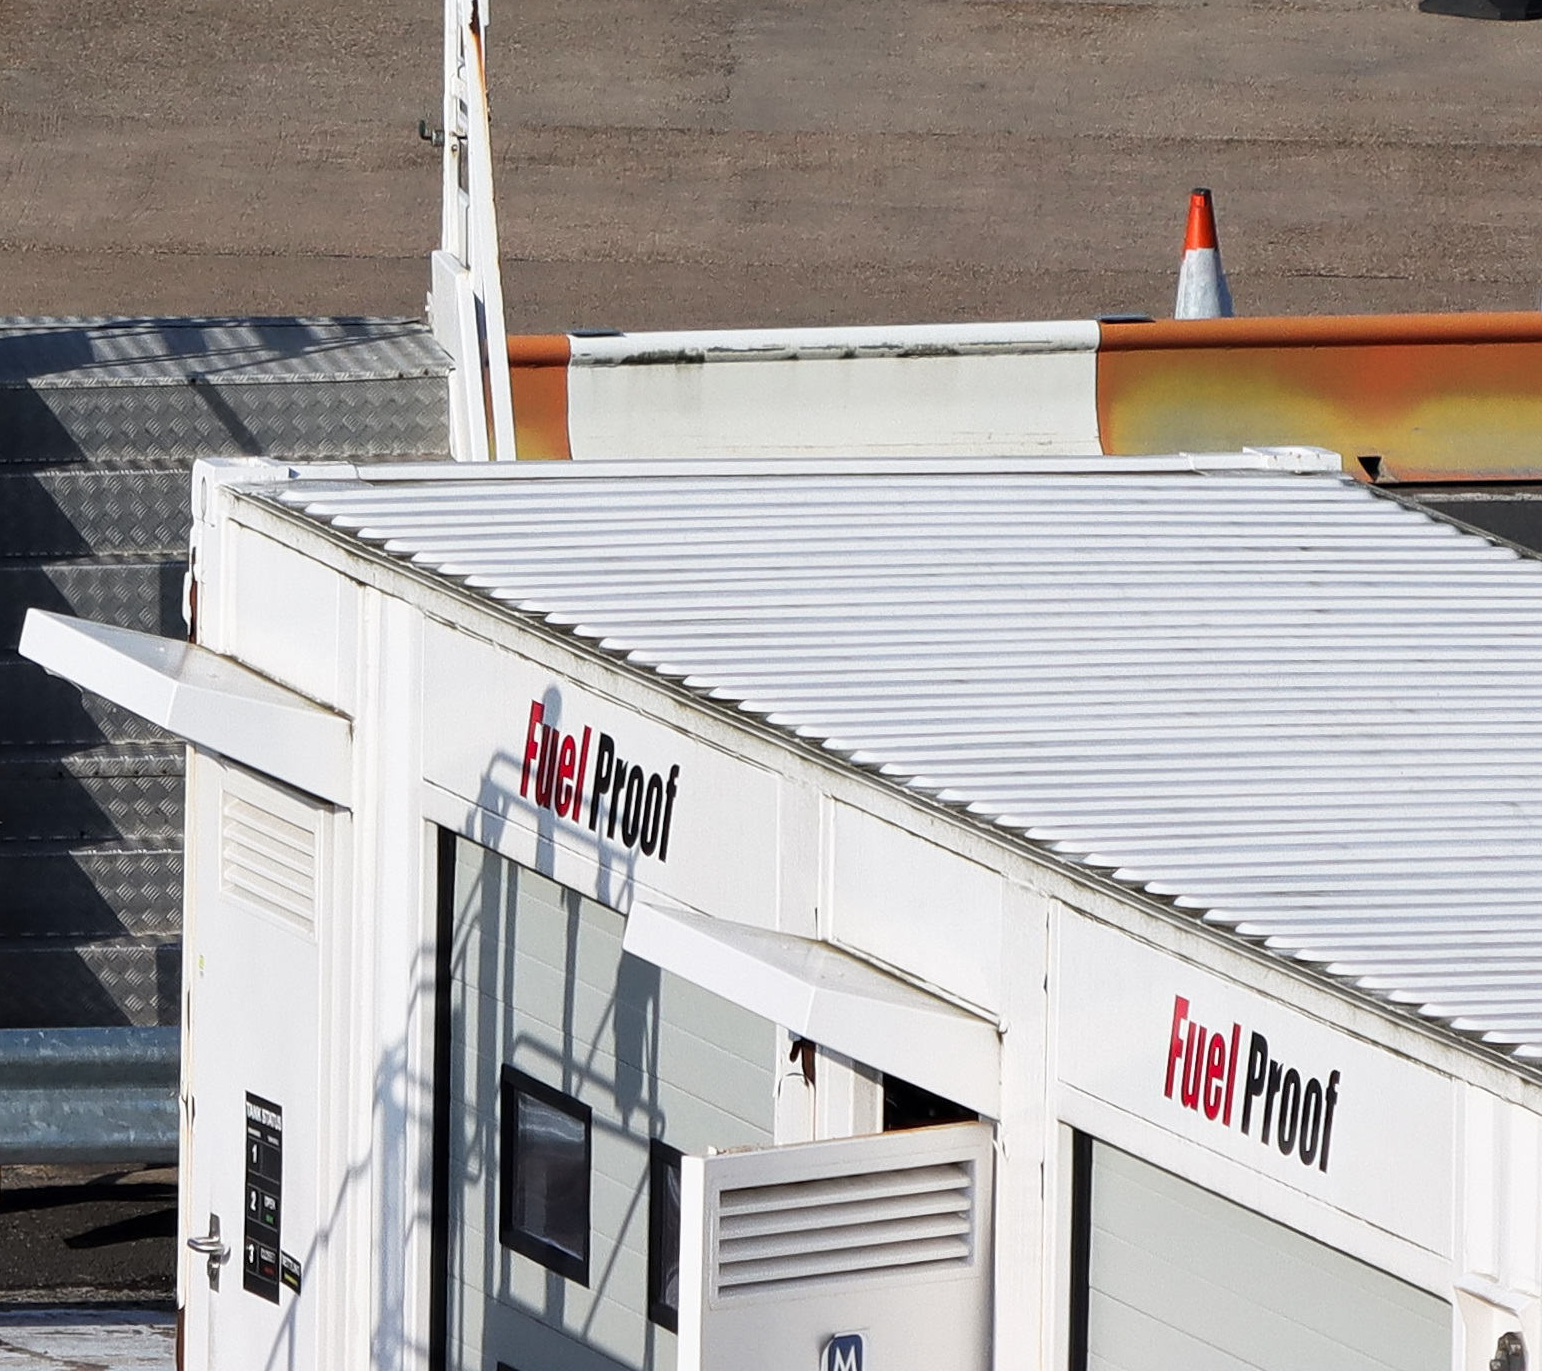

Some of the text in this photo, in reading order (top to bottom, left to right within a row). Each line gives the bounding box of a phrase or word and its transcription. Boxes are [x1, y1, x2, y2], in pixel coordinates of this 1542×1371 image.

[520, 701, 681, 863] Fuel Proof
[1163, 994, 1341, 1174] Fuel Proof
[245, 1101, 282, 1132] TANK STATUS
[251, 1143, 258, 1164] 1
[249, 1190, 257, 1213] 2
